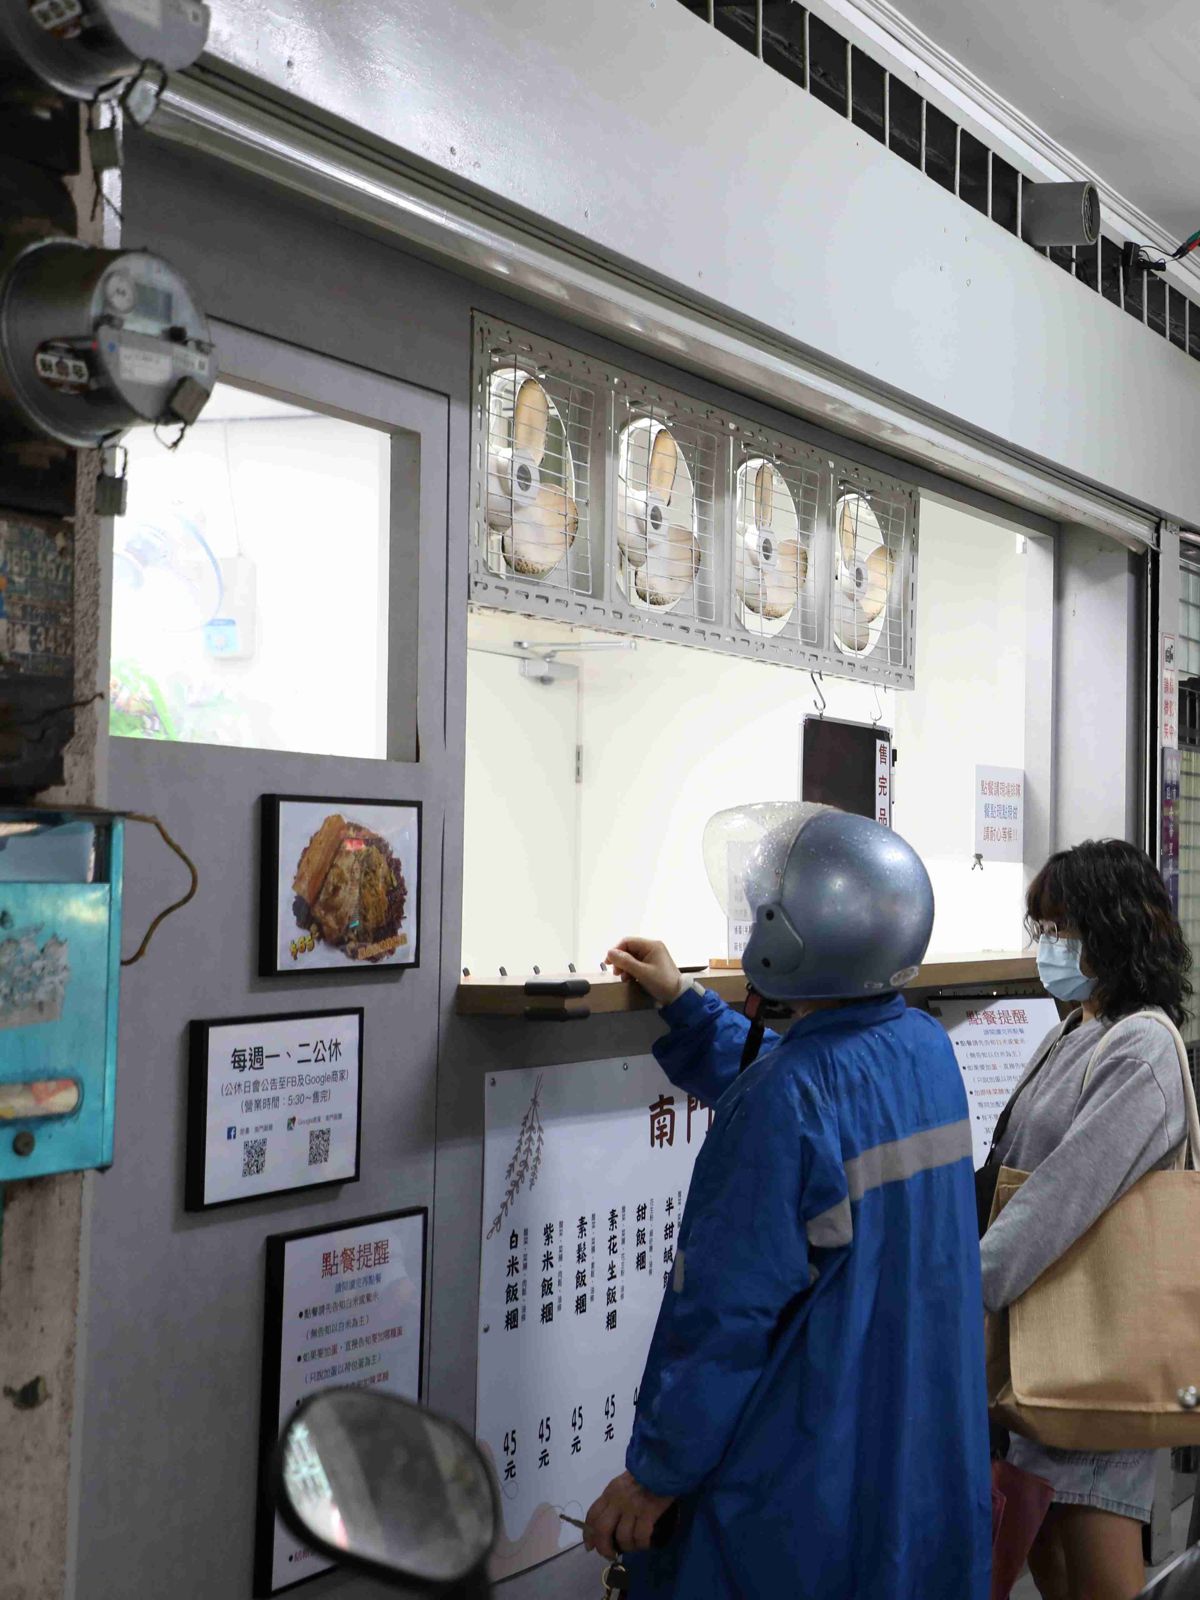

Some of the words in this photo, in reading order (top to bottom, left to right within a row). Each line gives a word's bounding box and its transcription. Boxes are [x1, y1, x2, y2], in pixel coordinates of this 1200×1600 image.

[965, 1009, 1029, 1026] 點餐提醒
[231, 1038, 342, 1073] 每週一、二公休
[321, 1239, 390, 1278] 點餐提醒
